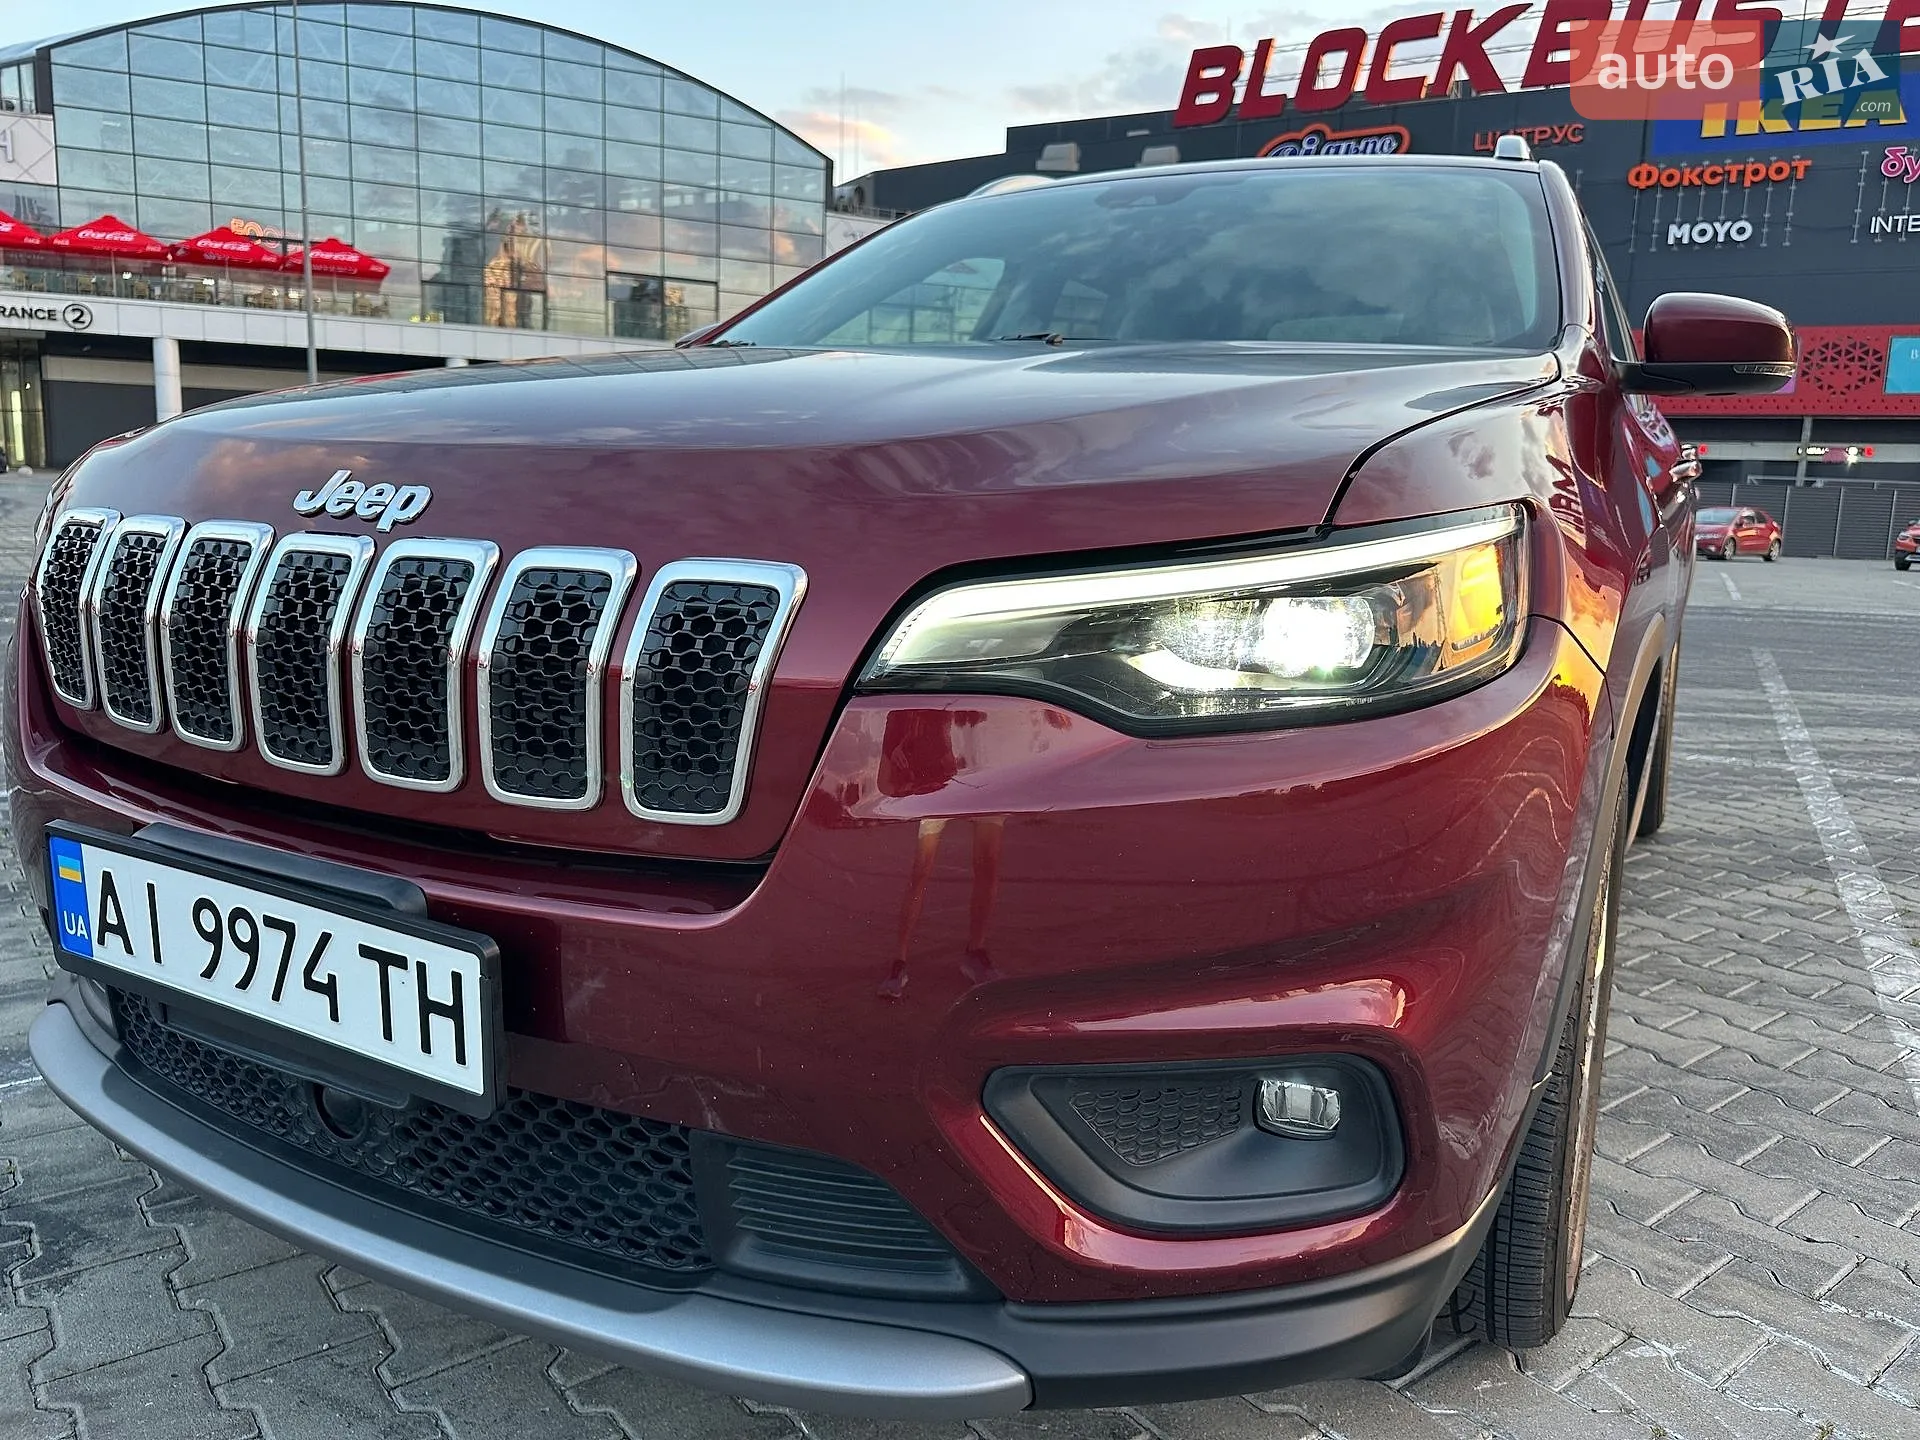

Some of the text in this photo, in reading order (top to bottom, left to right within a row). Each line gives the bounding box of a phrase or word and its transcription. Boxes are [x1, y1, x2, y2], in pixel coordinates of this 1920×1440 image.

[1627, 160, 1812, 189] Фокстрот
[1667, 220, 1752, 245] MOYO
[1870, 215, 1920, 234] INTE
[293, 470, 433, 533] Jeep
[64, 910, 89, 940] UA
[97, 869, 468, 1066] AI 9974 TH
